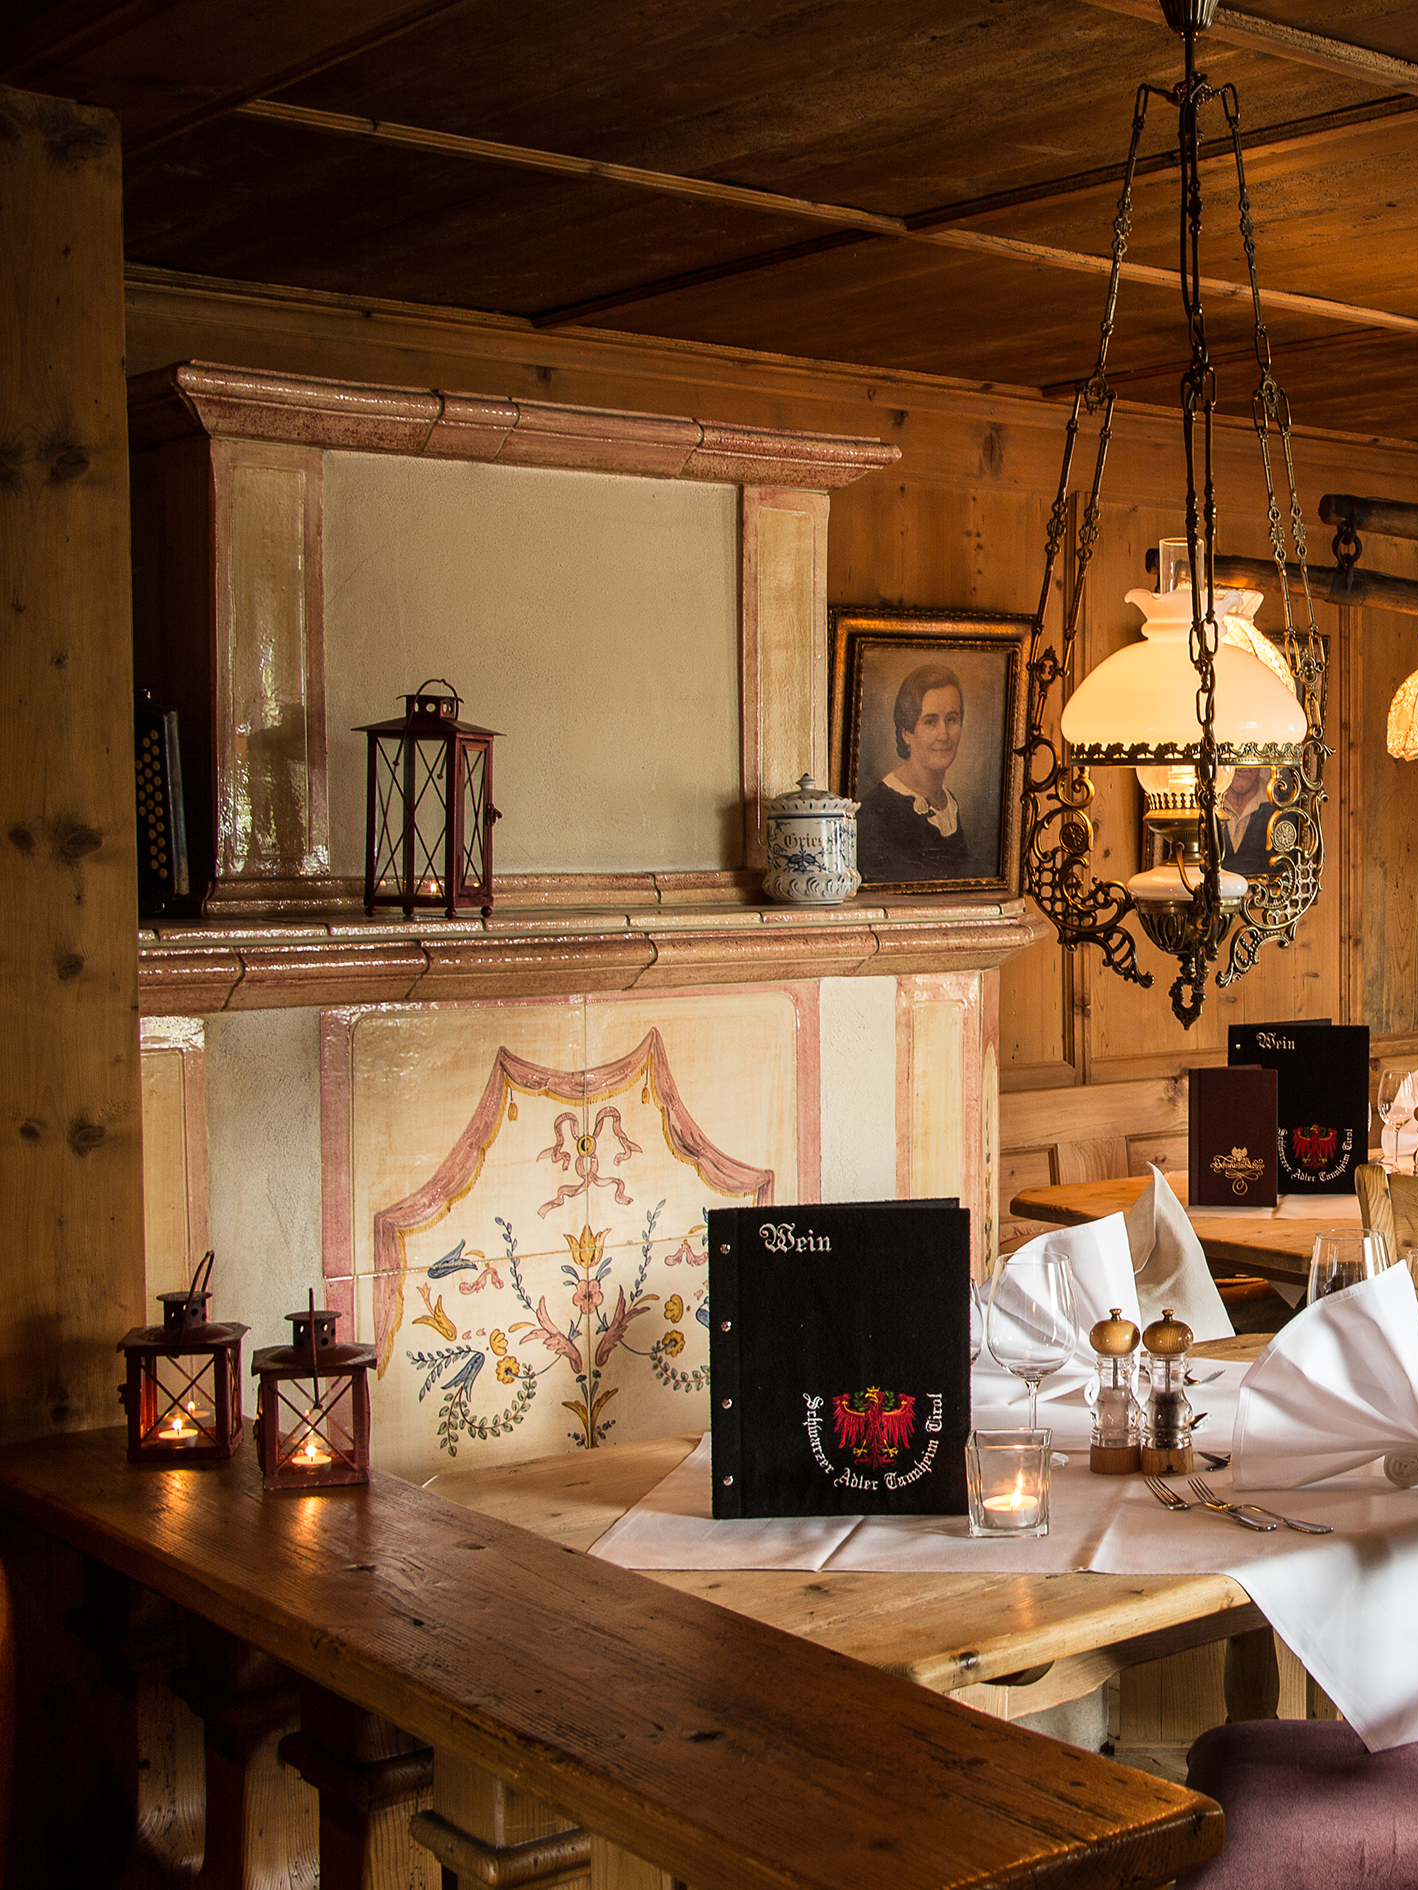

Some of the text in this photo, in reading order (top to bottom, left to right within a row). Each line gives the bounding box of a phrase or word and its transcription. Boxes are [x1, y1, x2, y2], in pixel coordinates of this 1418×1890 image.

[1256, 1031, 1295, 1050] Wein
[1290, 1168, 1316, 1182] Adler
[1318, 1153, 1350, 1182] Tannheim
[1341, 1128, 1353, 1151] Tirol
[759, 1222, 833, 1254] Wein
[802, 1393, 943, 1490] Schwarzer Adler Tannheim Tirol
